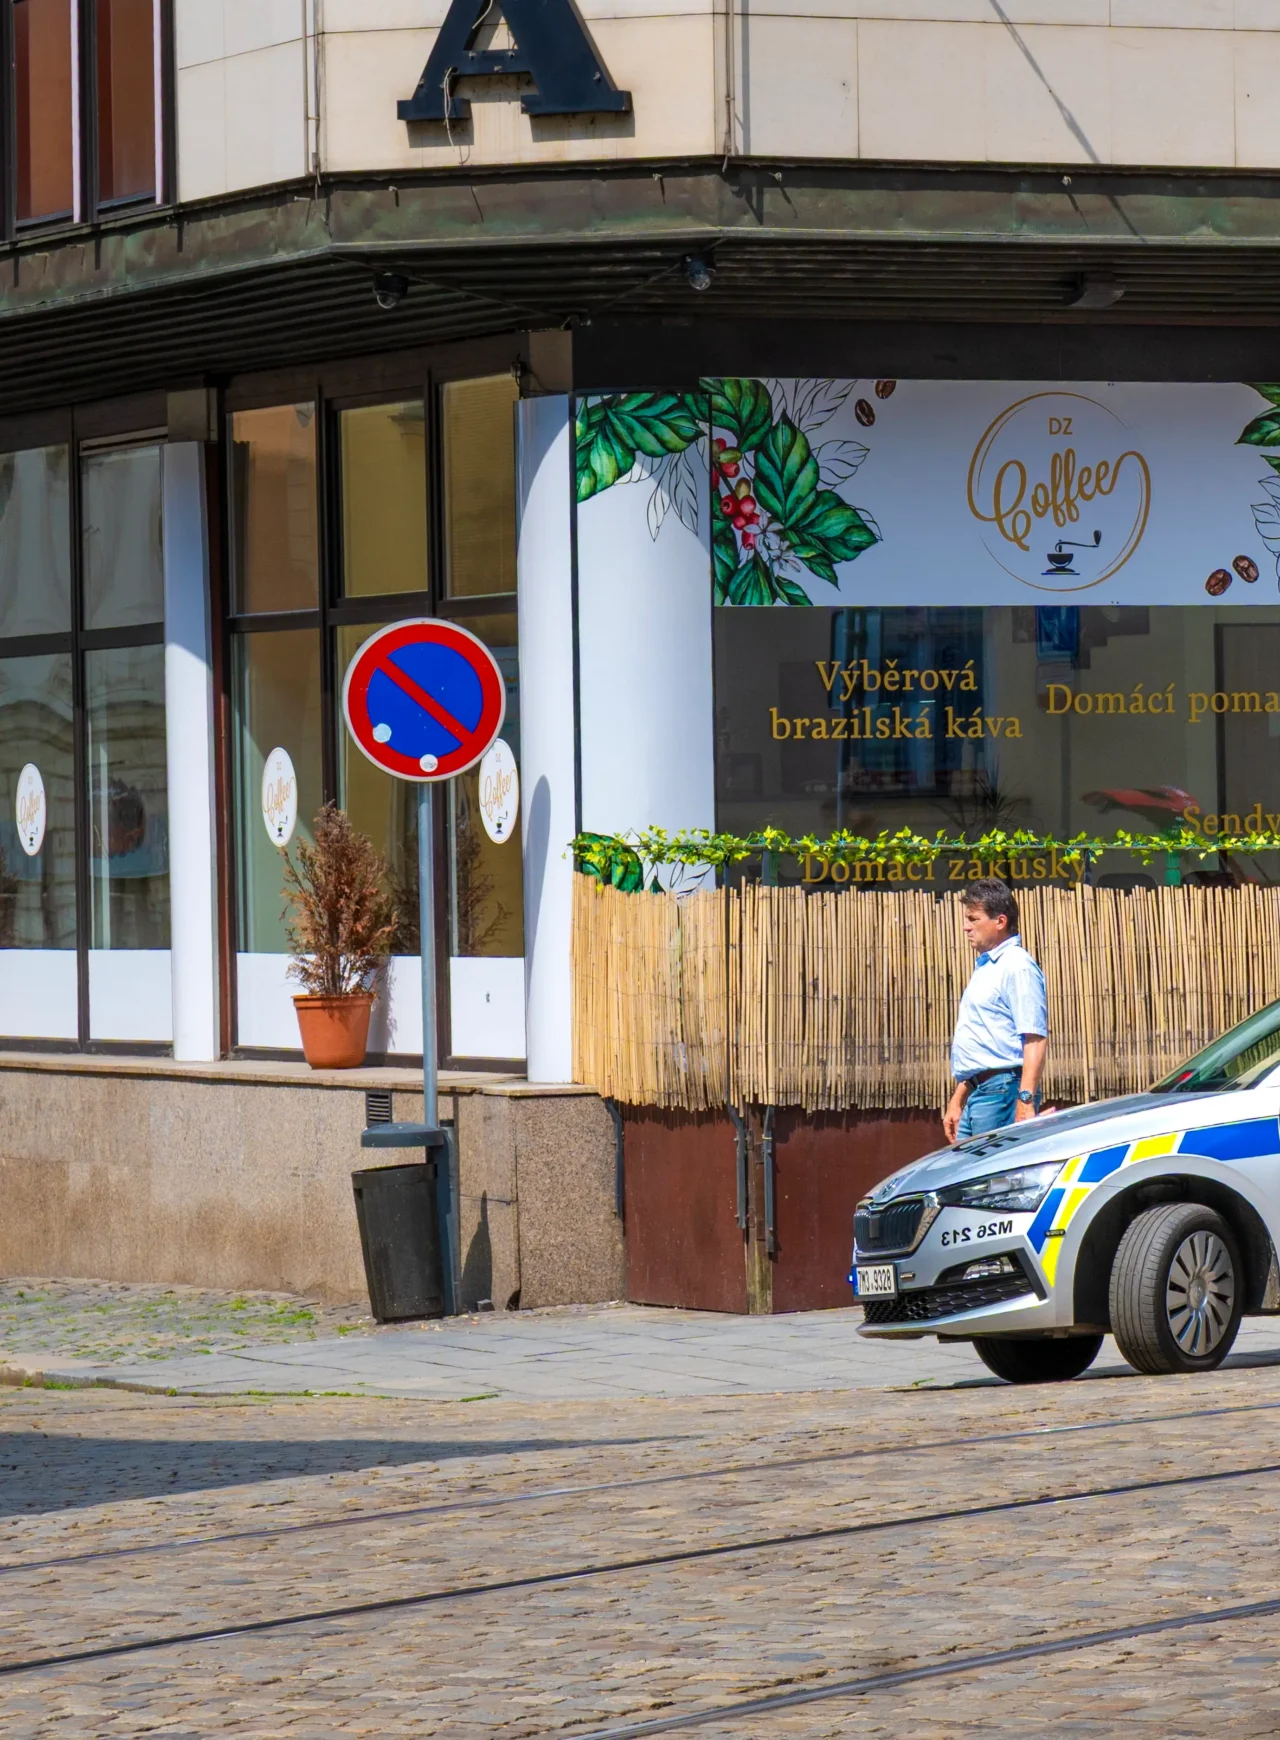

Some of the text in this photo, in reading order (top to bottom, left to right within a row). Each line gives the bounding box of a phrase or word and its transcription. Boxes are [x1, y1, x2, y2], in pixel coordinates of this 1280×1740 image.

[397, 0, 632, 116] A
[1048, 417, 1073, 435] DZ
[993, 448, 1125, 552] Coffee
[814, 658, 979, 701] Výběrová
[1045, 682, 1176, 714] Domácí
[768, 705, 1024, 740] brazilská káva
[481, 768, 516, 822] Coffee
[873, 1269, 892, 1291] 9328
